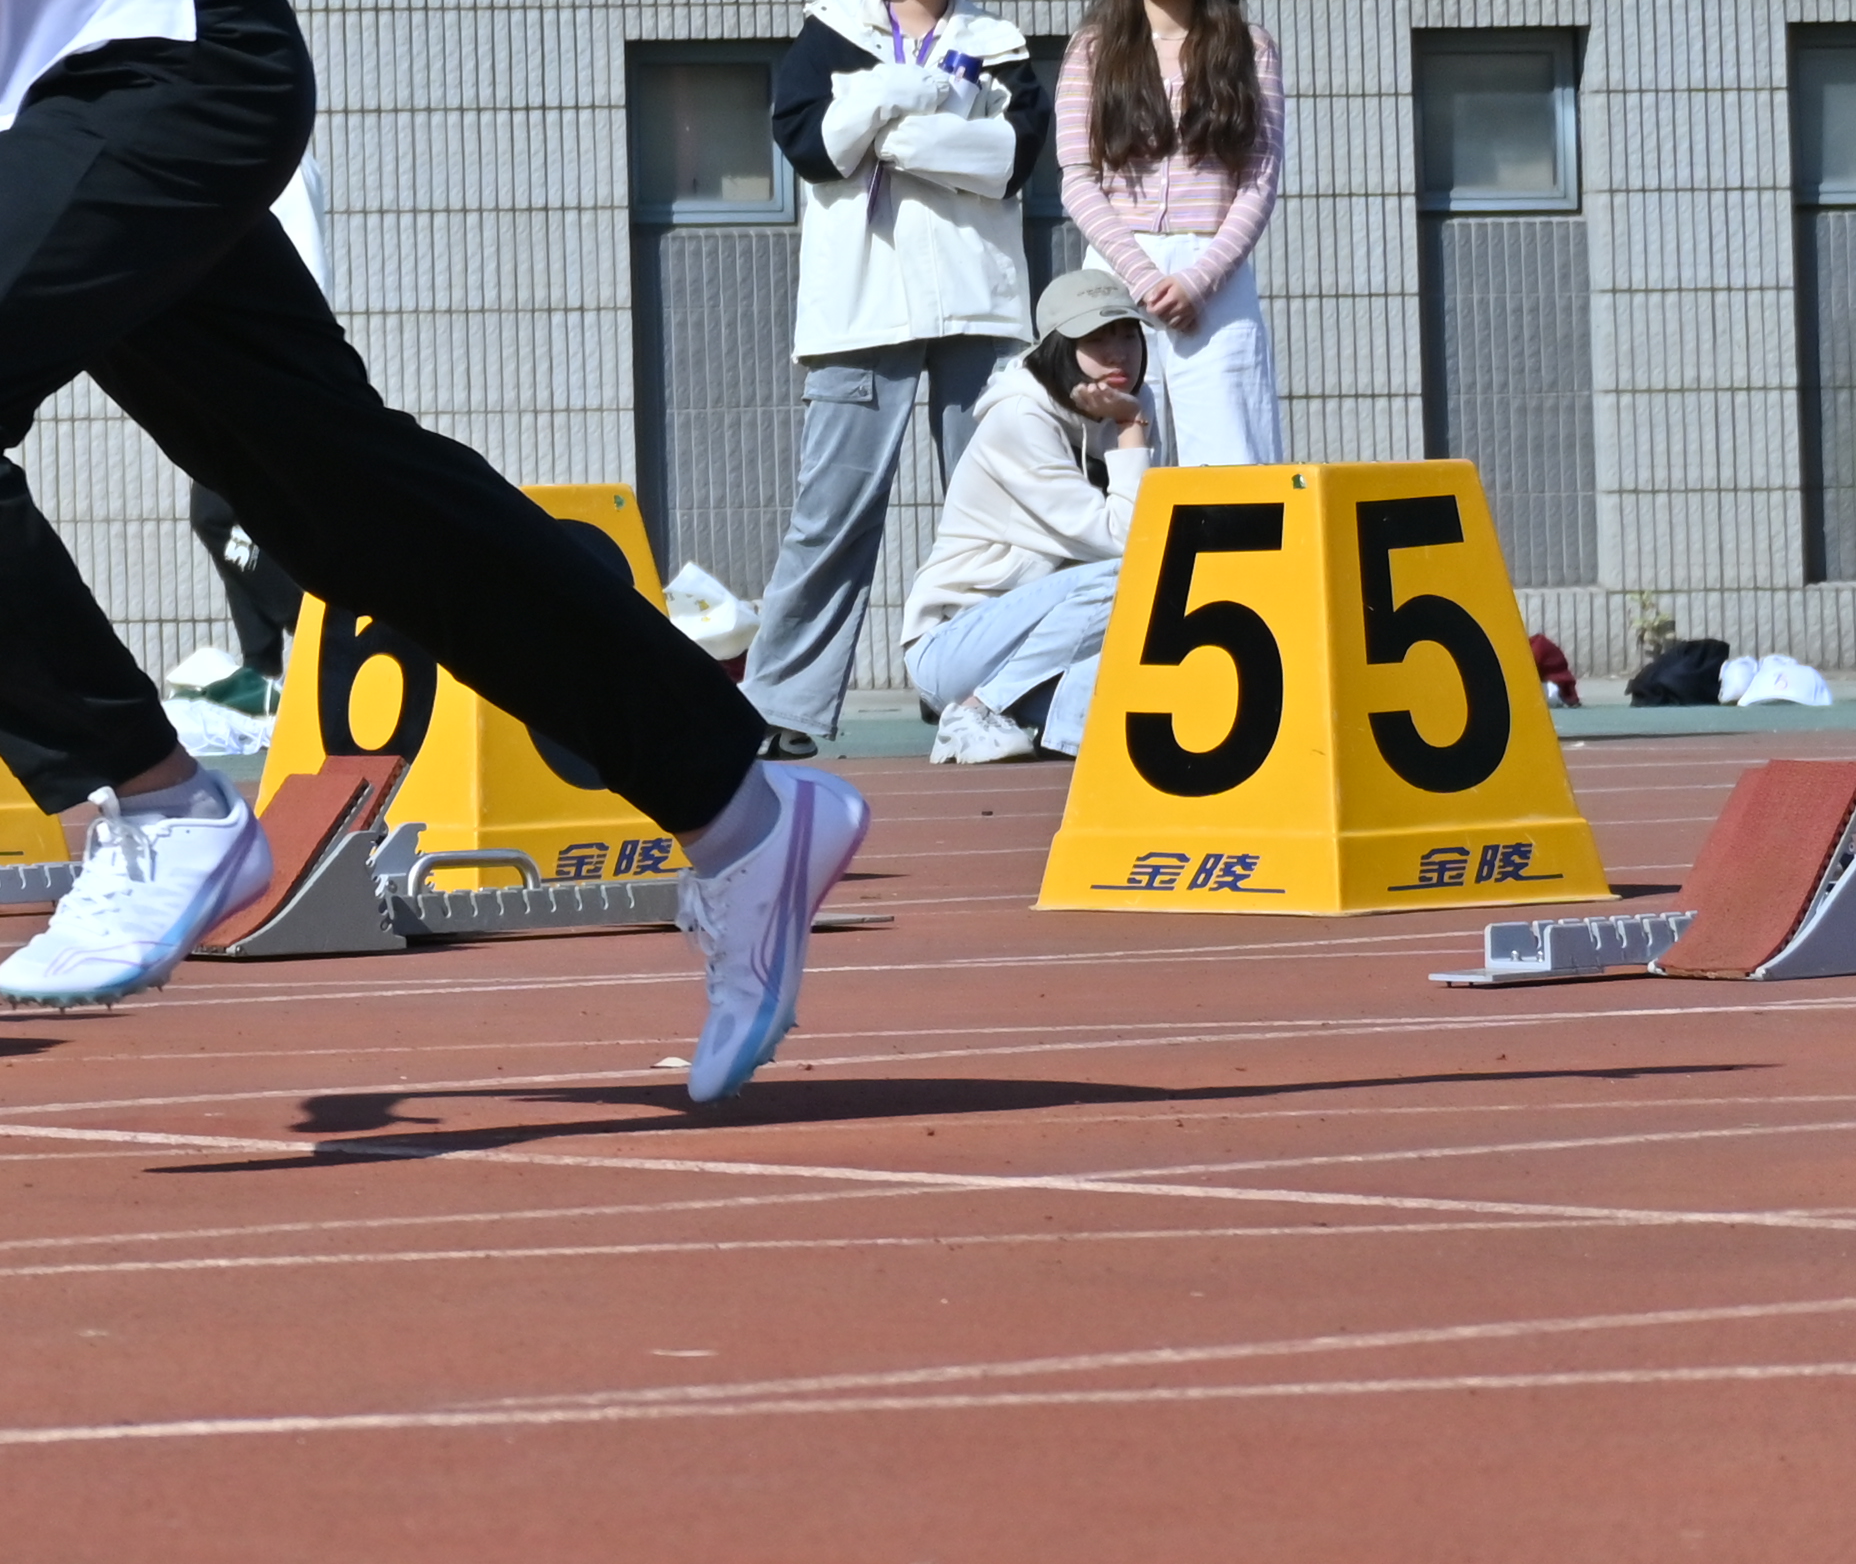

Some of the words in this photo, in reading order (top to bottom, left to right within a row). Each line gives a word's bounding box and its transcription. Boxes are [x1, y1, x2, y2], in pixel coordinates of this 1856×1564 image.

[1125, 502, 1285, 797] 5
[1355, 494, 1511, 793] 5
[542, 837, 693, 882] 金陵
[1090, 851, 1286, 893] 金陵
[1387, 841, 1564, 892] 金陵
